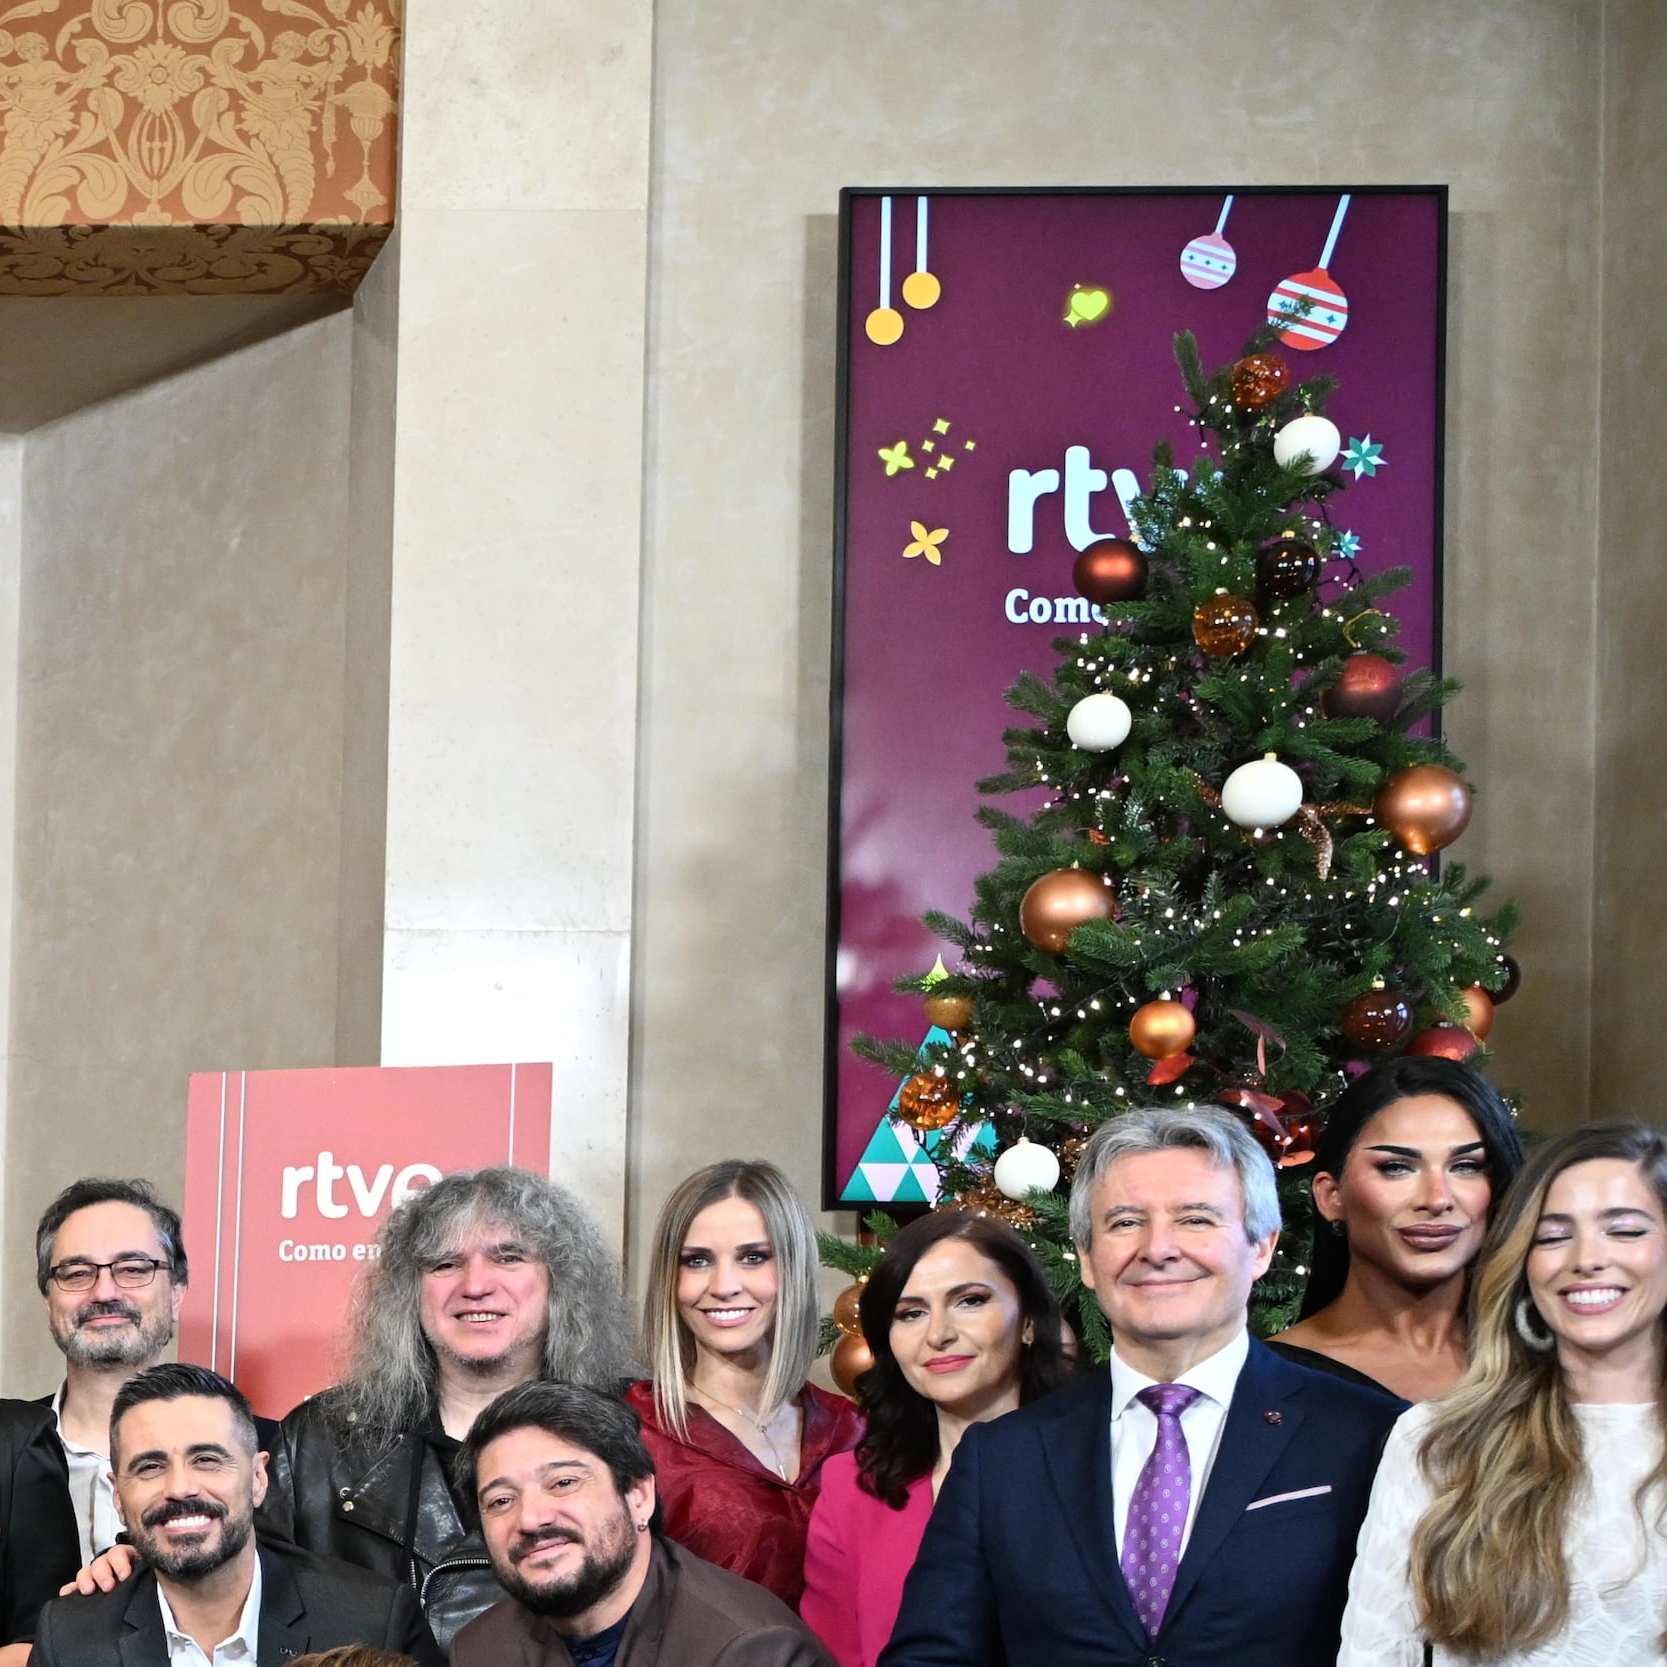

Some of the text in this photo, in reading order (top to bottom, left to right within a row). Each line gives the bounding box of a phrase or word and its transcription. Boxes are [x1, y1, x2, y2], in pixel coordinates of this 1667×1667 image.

[1008, 445, 1224, 553] rtv
[281, 1150, 444, 1219] rtve
[278, 1239, 347, 1262] Como
